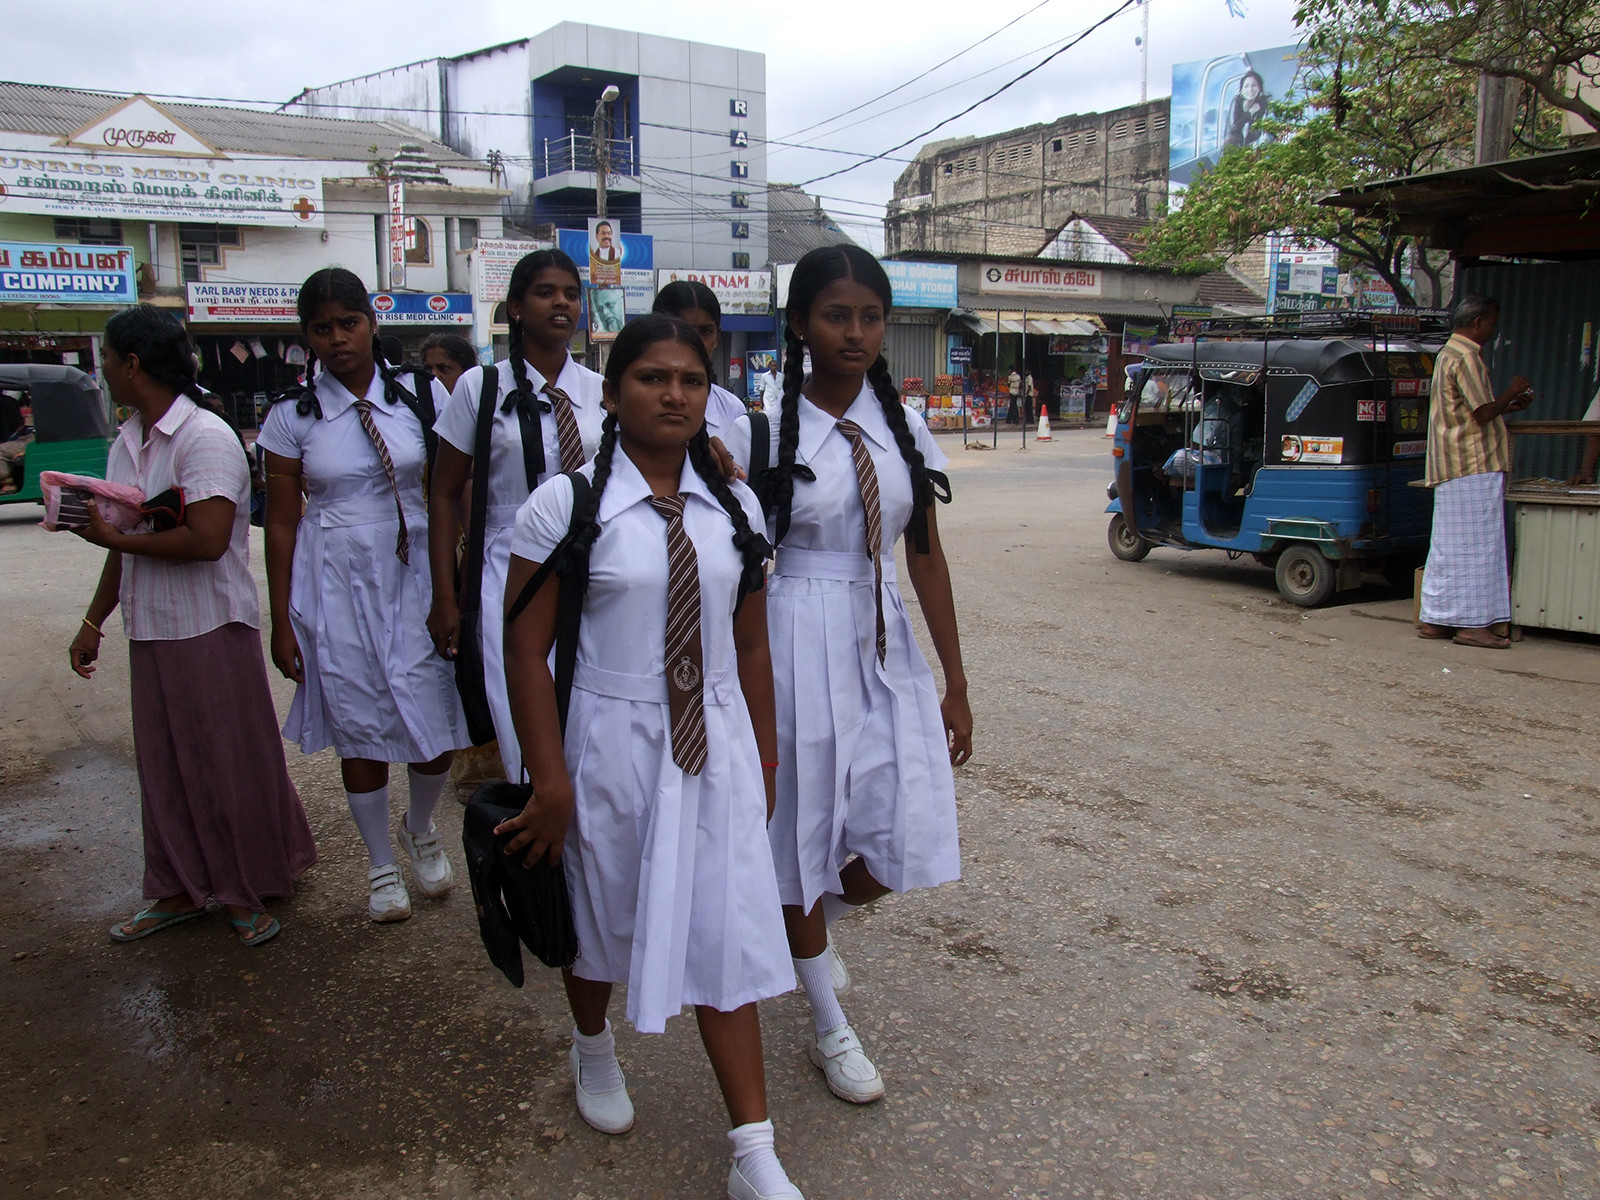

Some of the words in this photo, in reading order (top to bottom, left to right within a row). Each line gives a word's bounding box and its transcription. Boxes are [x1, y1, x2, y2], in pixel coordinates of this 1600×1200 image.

[103, 127, 176, 148] முருகன்
[0, 156, 124, 177] UNRISE
[131, 166, 210, 183] MEDI
[218, 173, 316, 190] CLINIC
[3, 273, 120, 292] COMPANY
[687, 274, 749, 288] RATNAM
[1004, 268, 1061, 284] சுபாஸ்
[1063, 270, 1095, 286] கபே
[195, 286, 219, 295] YARL
[221, 286, 247, 296] BABY
[249, 287, 279, 297] NEEDS
[281, 288, 287, 297] &
[921, 282, 954, 293] STORES
[385, 313, 404, 321] RISE
[1359, 402, 1384, 414] NGK
[1307, 443, 1334, 452] SART
